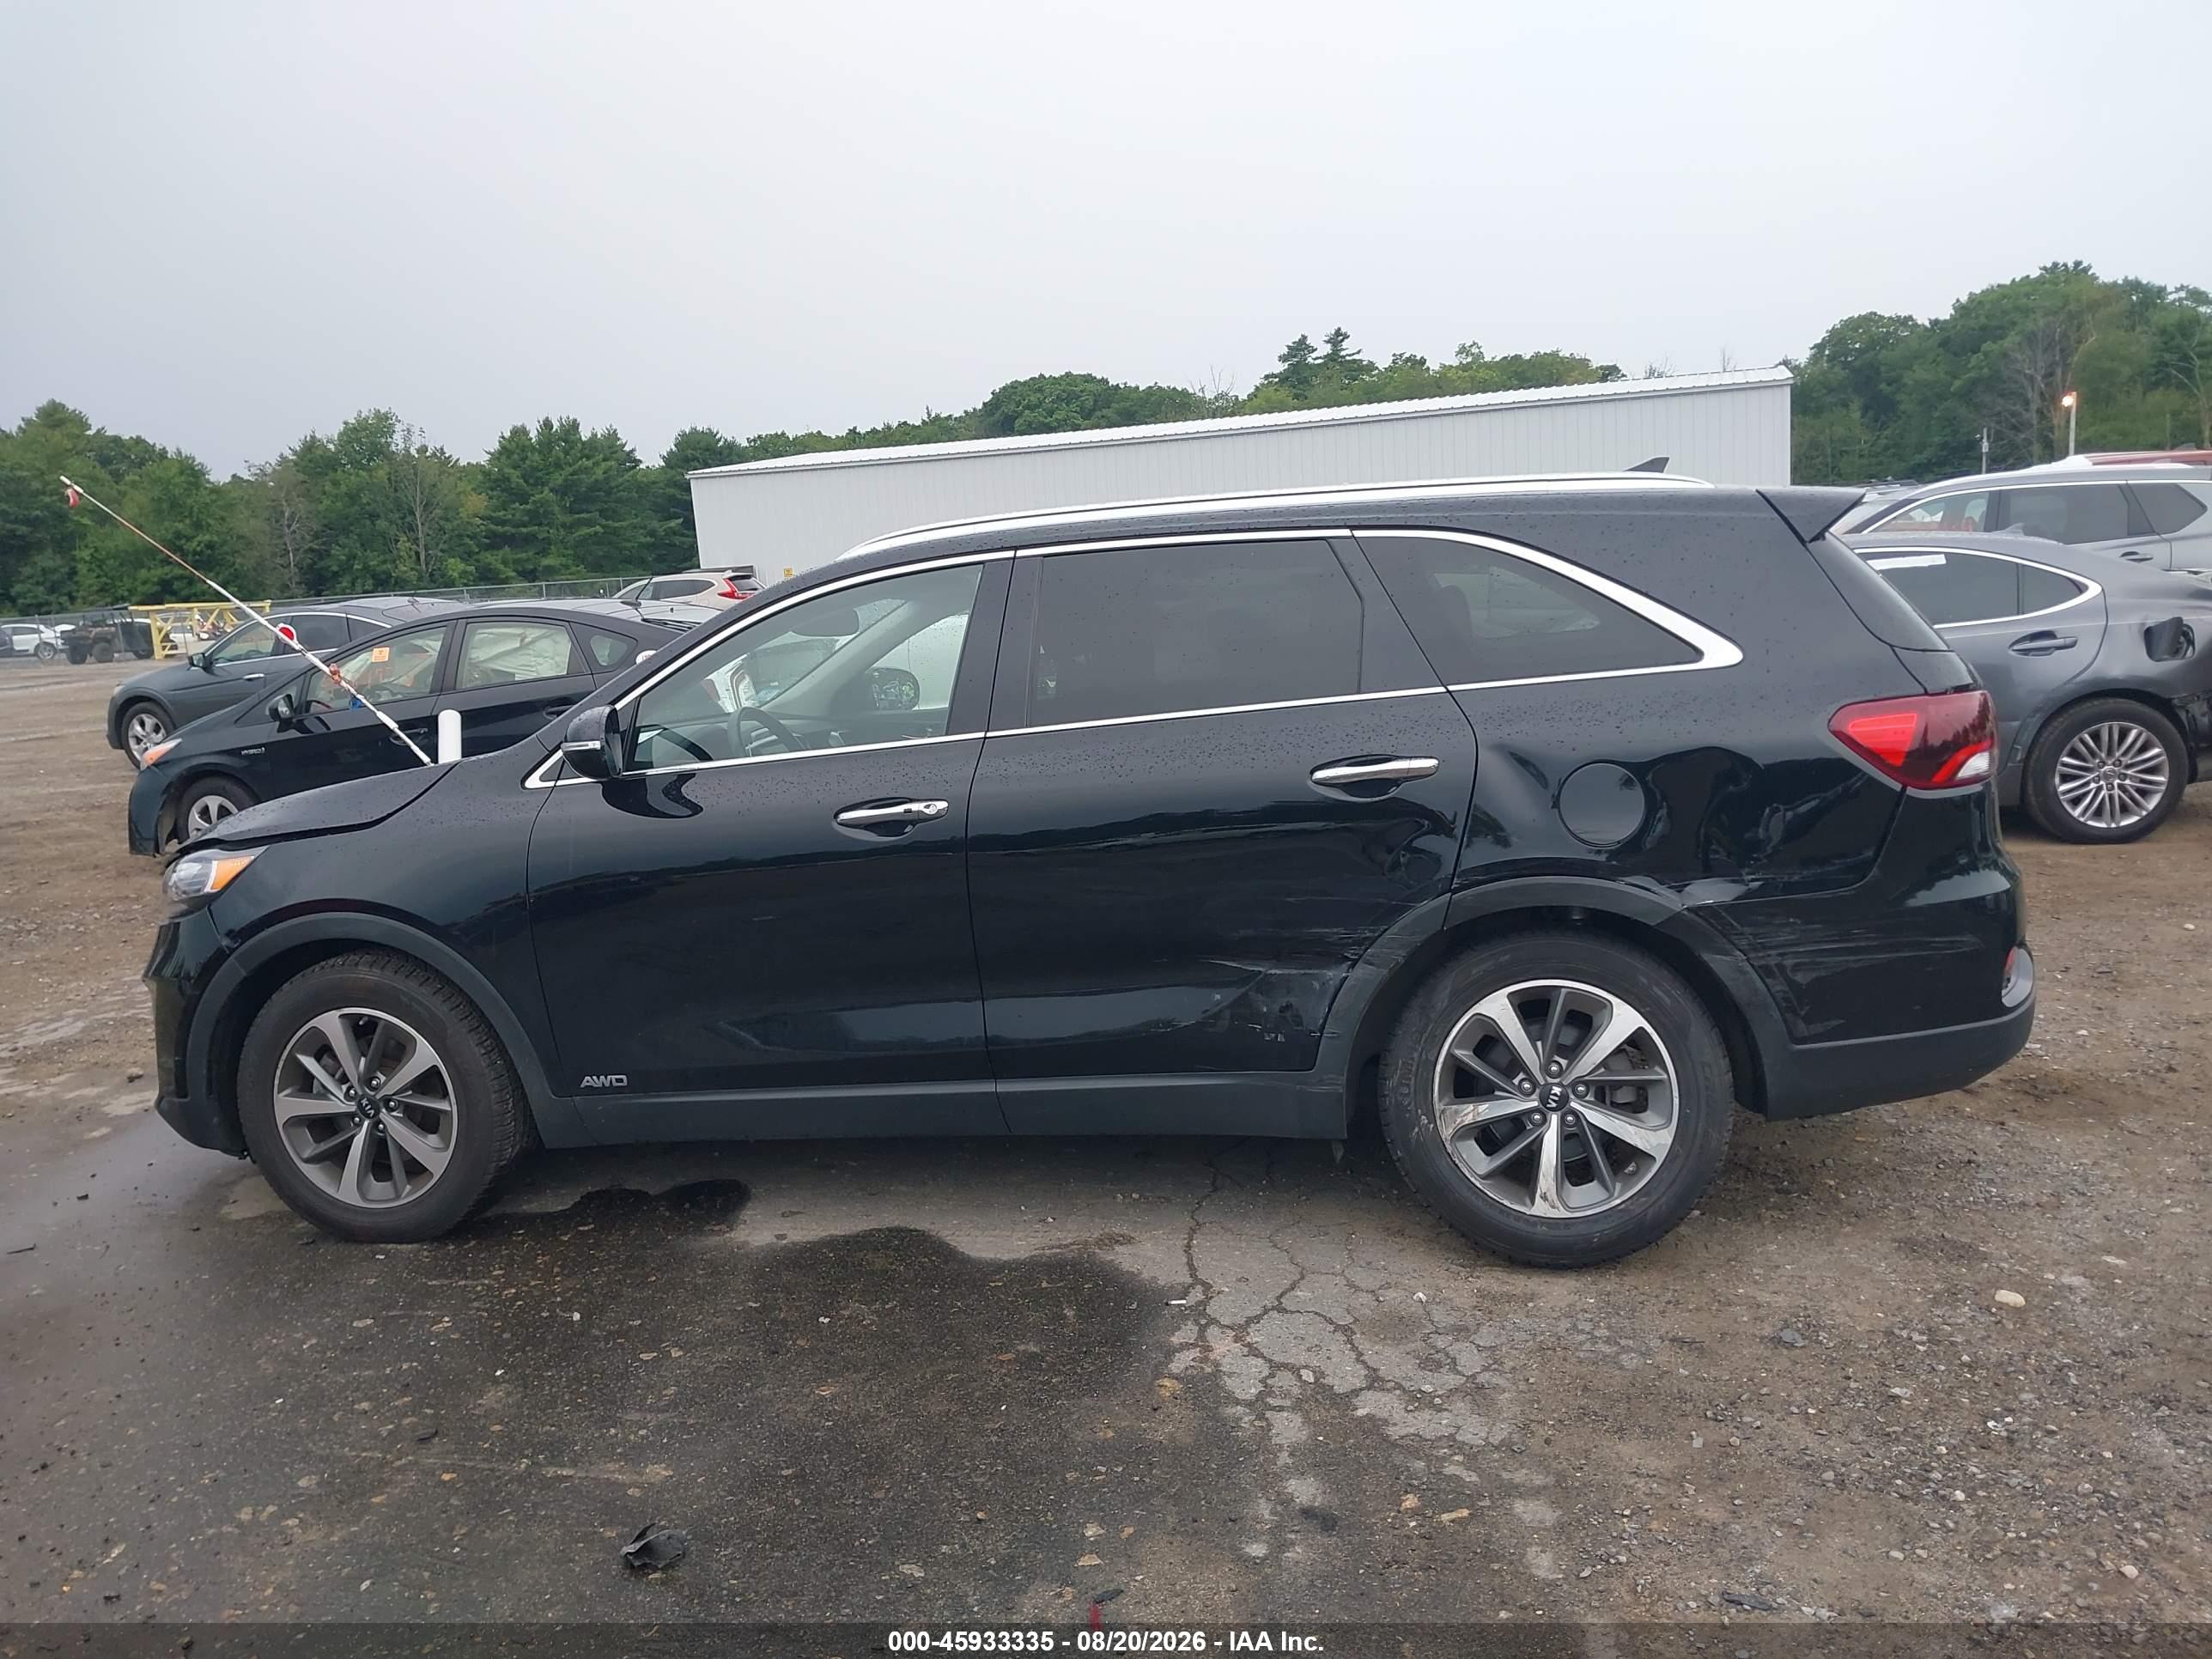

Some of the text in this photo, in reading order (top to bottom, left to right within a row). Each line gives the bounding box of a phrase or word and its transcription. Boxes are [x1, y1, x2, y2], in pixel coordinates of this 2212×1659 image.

[580, 1074, 628, 1088] AWD
[1547, 1085, 1562, 1108] KIA
[361, 1098, 375, 1118] KIA
